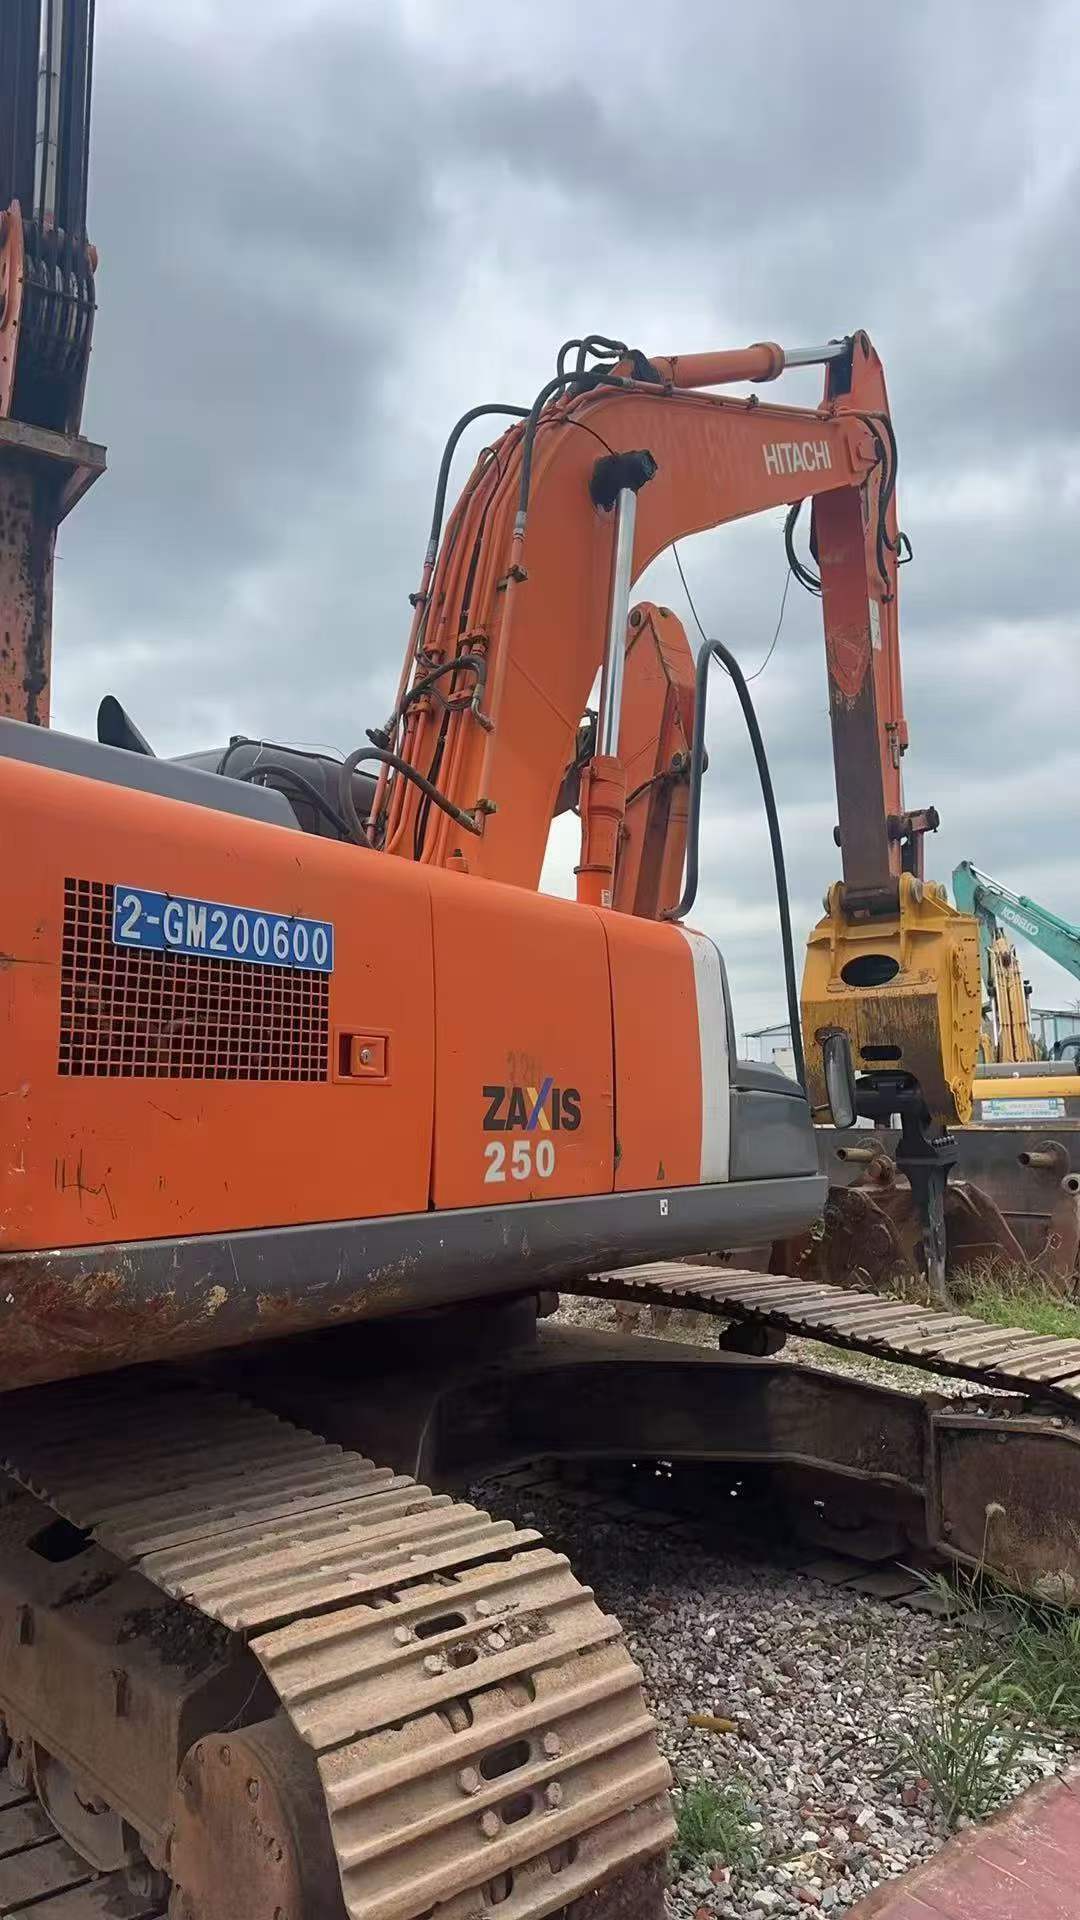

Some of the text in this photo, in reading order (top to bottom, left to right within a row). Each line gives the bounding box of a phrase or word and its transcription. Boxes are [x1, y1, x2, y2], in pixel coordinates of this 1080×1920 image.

[762, 440, 832, 475] HITACHI
[121, 895, 328, 965] 2-GM200600
[1001, 906, 1038, 935] KOBELCO
[483, 1077, 581, 1130] ZAXIS
[485, 1139, 554, 1183] 250
